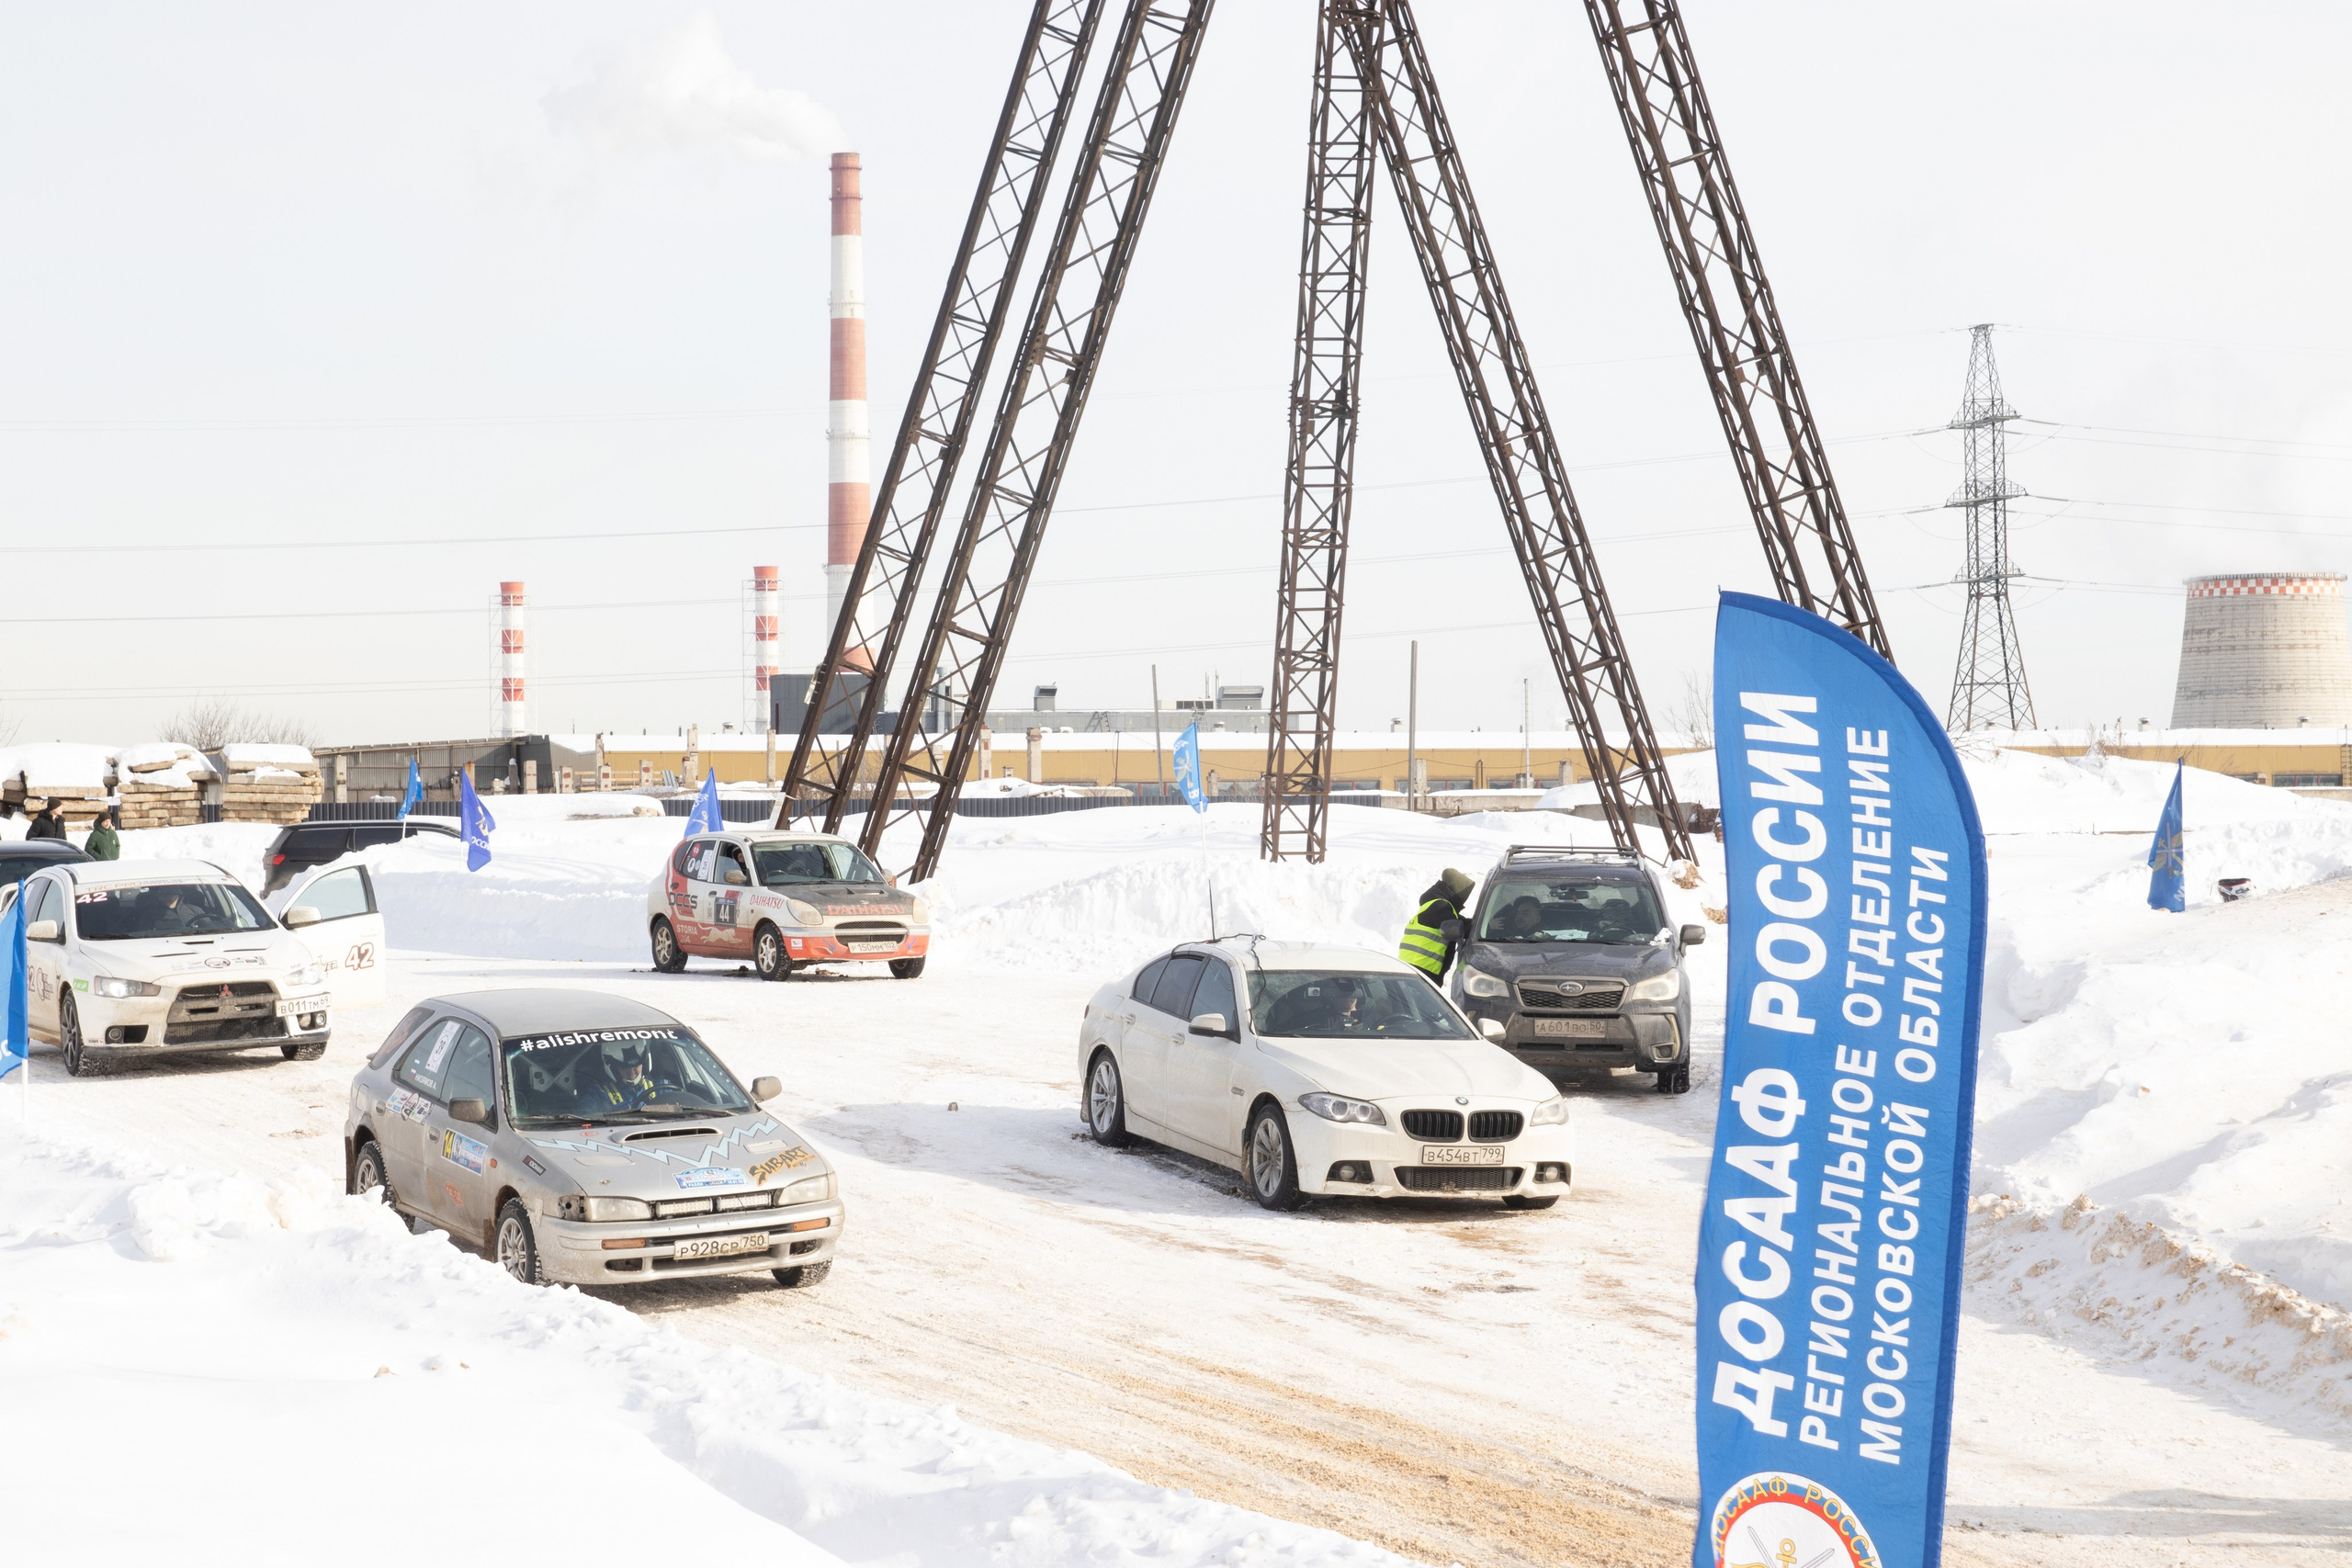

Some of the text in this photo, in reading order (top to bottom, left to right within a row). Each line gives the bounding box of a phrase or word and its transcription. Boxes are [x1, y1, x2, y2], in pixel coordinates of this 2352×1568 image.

[76, 892, 108, 904] 42
[669, 892, 698, 909] DCCS
[750, 894, 785, 909] DAIHATSU
[719, 904, 729, 922] 44
[827, 903, 906, 915] DAIHATSU
[676, 924, 698, 935] STORIA
[345, 942, 374, 970] 42
[520, 1029, 678, 1053] #alishremont
[1712, 691, 1828, 1438] ДОСААФ РОССИИ
[1799, 727, 1896, 1451] РЕГИОНАЛЬНОЕ ОТДЕЛЕНИЕ
[444, 1130, 456, 1159] 14
[1482, 1147, 1501, 1159] 799
[1859, 846, 1949, 1465] МОСКОВСКОЙ ОБЛАСТИ
[742, 1235, 764, 1248] 750
